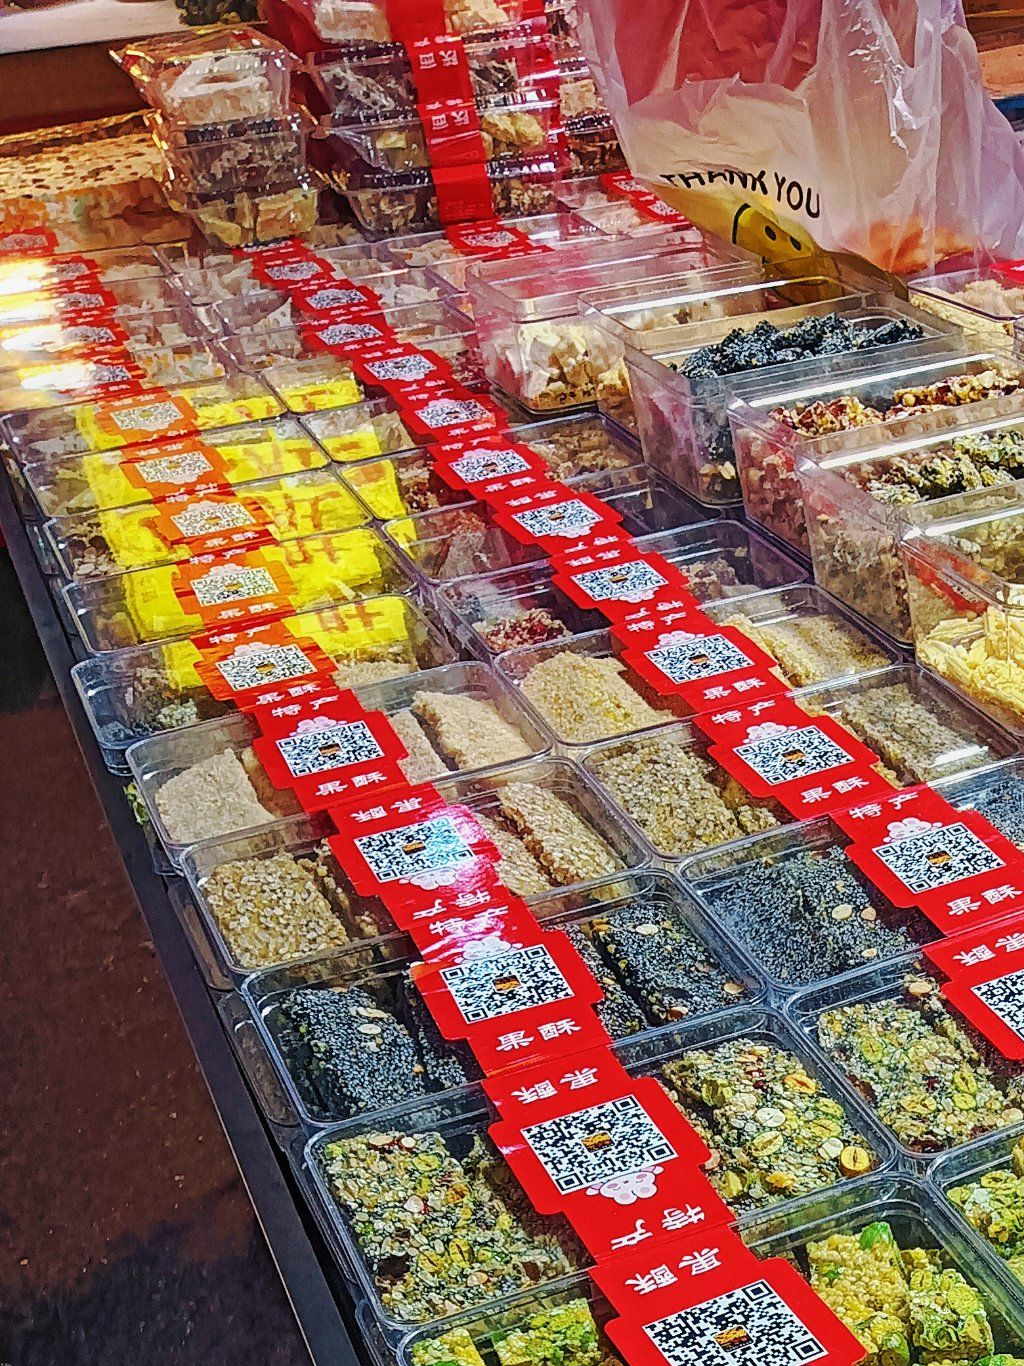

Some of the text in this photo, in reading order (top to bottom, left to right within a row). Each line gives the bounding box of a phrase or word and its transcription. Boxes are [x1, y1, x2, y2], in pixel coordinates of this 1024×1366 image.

[774, 172, 821, 219] YOU
[848, 789, 920, 820] 特产
[947, 883, 1024, 917] 果酥
[496, 1017, 583, 1052] 果酥
[511, 1066, 600, 1105] 果酥
[611, 1203, 706, 1250] 特产
[625, 1246, 722, 1295] 果酥
